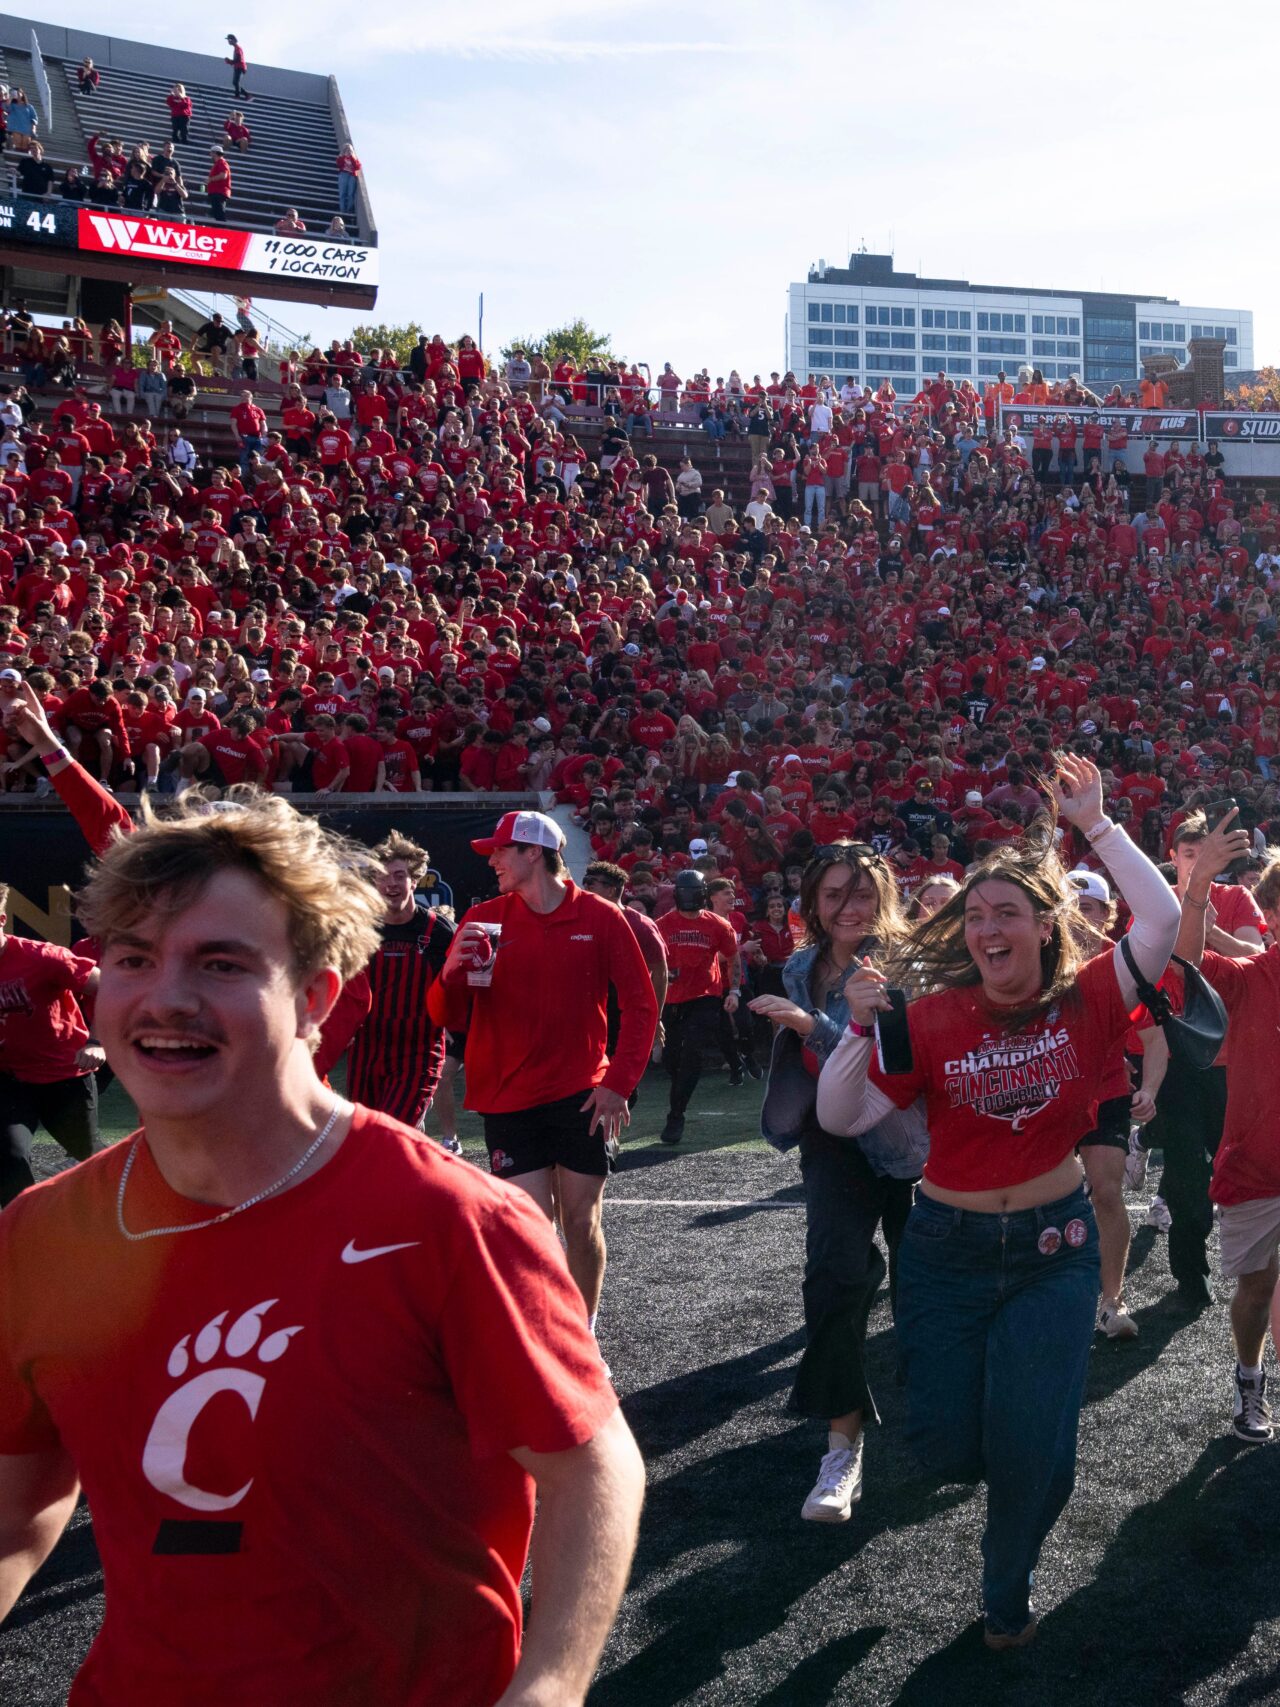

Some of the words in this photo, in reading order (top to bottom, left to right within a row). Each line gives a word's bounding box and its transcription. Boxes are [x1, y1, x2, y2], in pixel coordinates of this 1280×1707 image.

[26, 211, 56, 234] 44
[143, 224, 228, 253] Wyler
[322, 246, 368, 263] CARS
[269, 258, 278, 270] 1
[281, 261, 361, 280] LOCATION
[757, 410, 766, 421] 5
[969, 706, 987, 722] 17
[944, 1027, 1071, 1076] CHAMPIONS
[944, 1043, 1080, 1109] CINCINNATI
[974, 1079, 1061, 1117] FOOTBALL
